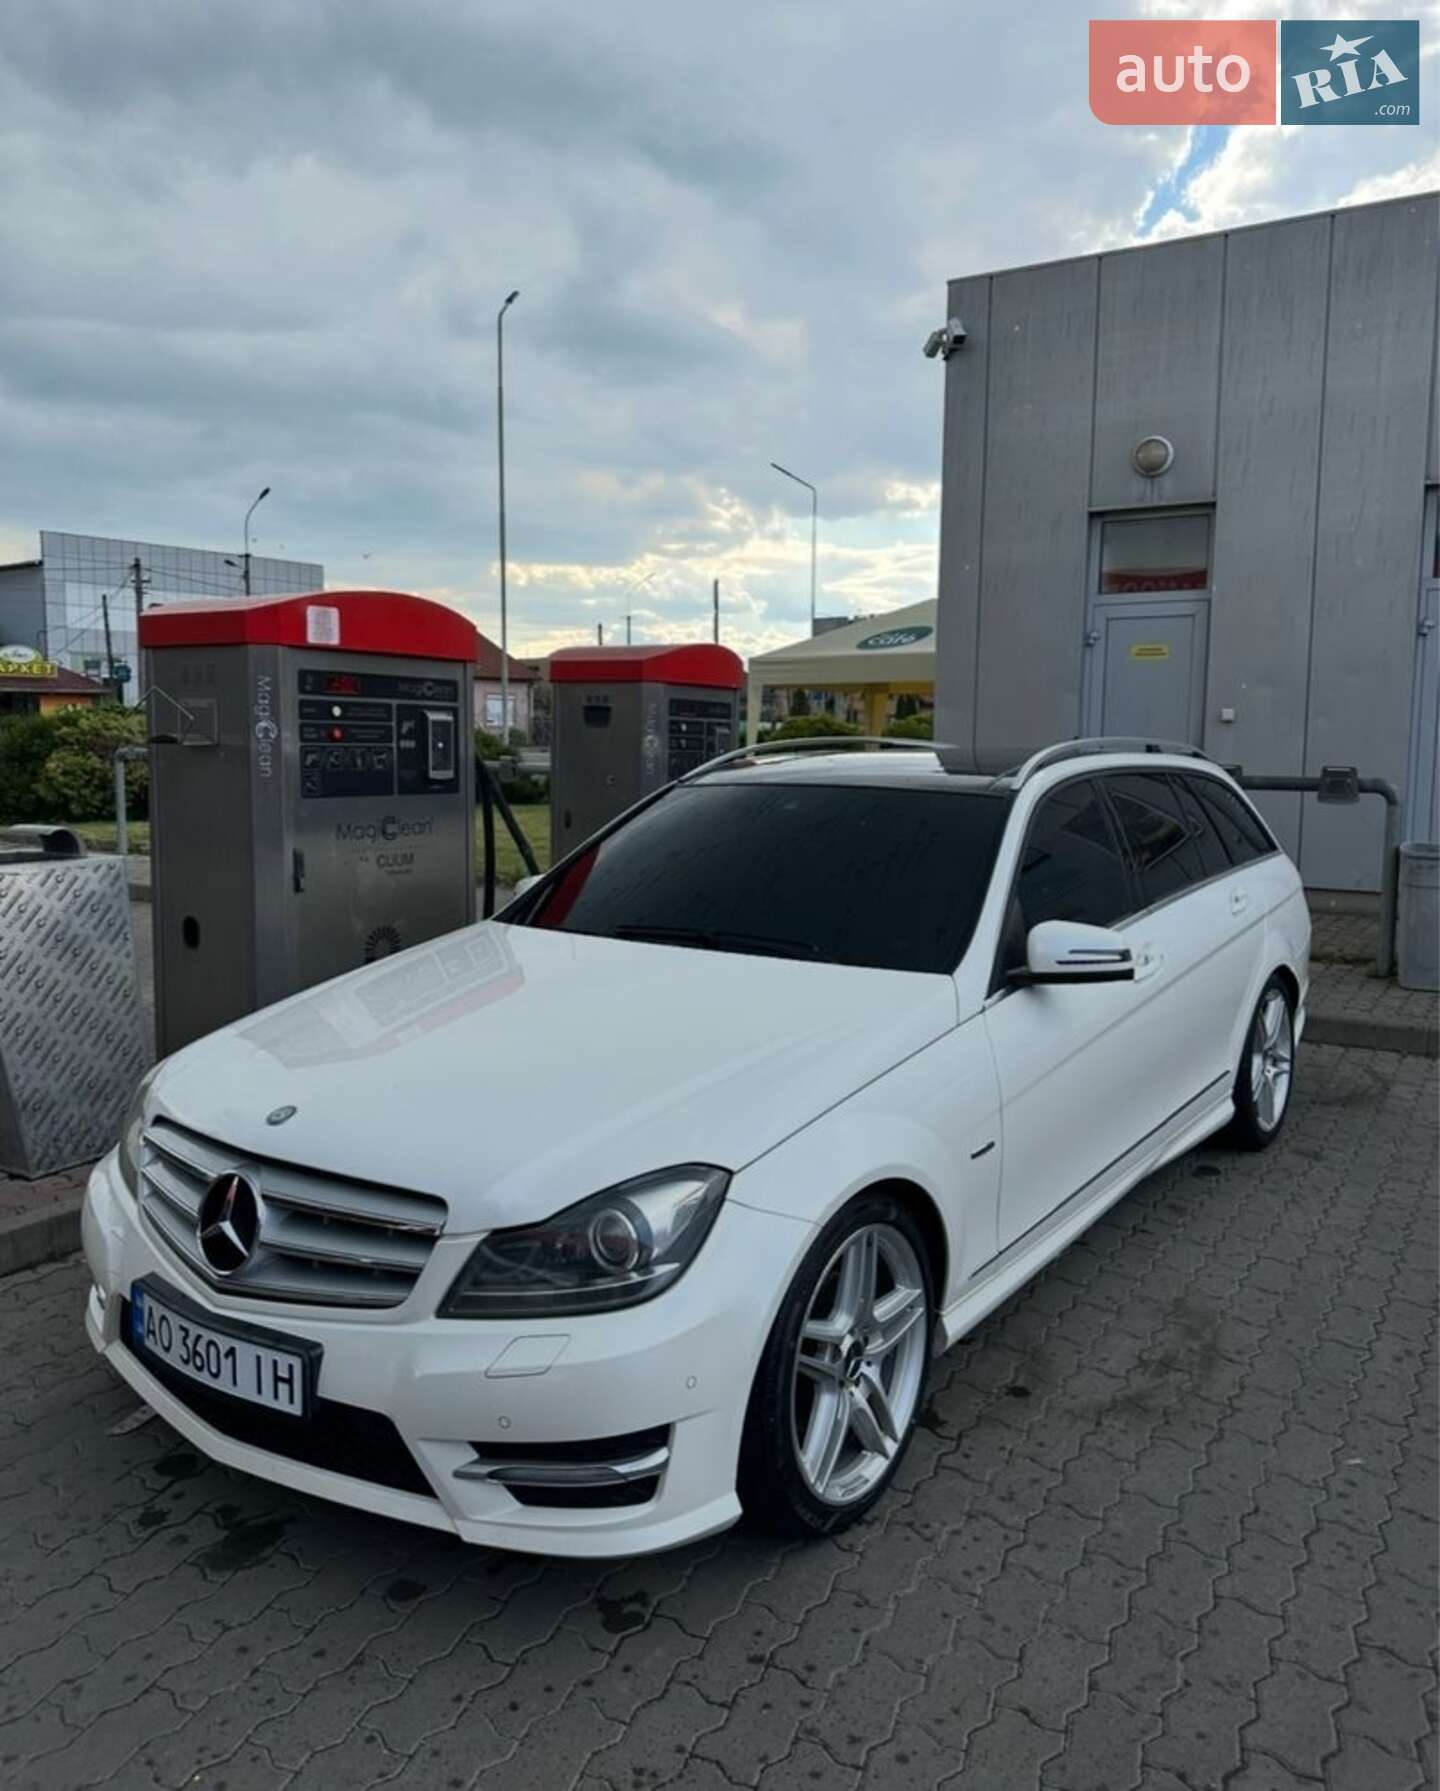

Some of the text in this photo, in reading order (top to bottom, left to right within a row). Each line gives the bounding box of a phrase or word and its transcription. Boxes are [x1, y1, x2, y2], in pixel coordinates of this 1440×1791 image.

[255, 675, 279, 778] MagClean
[146, 1304, 295, 1405] AO 3601 IH
